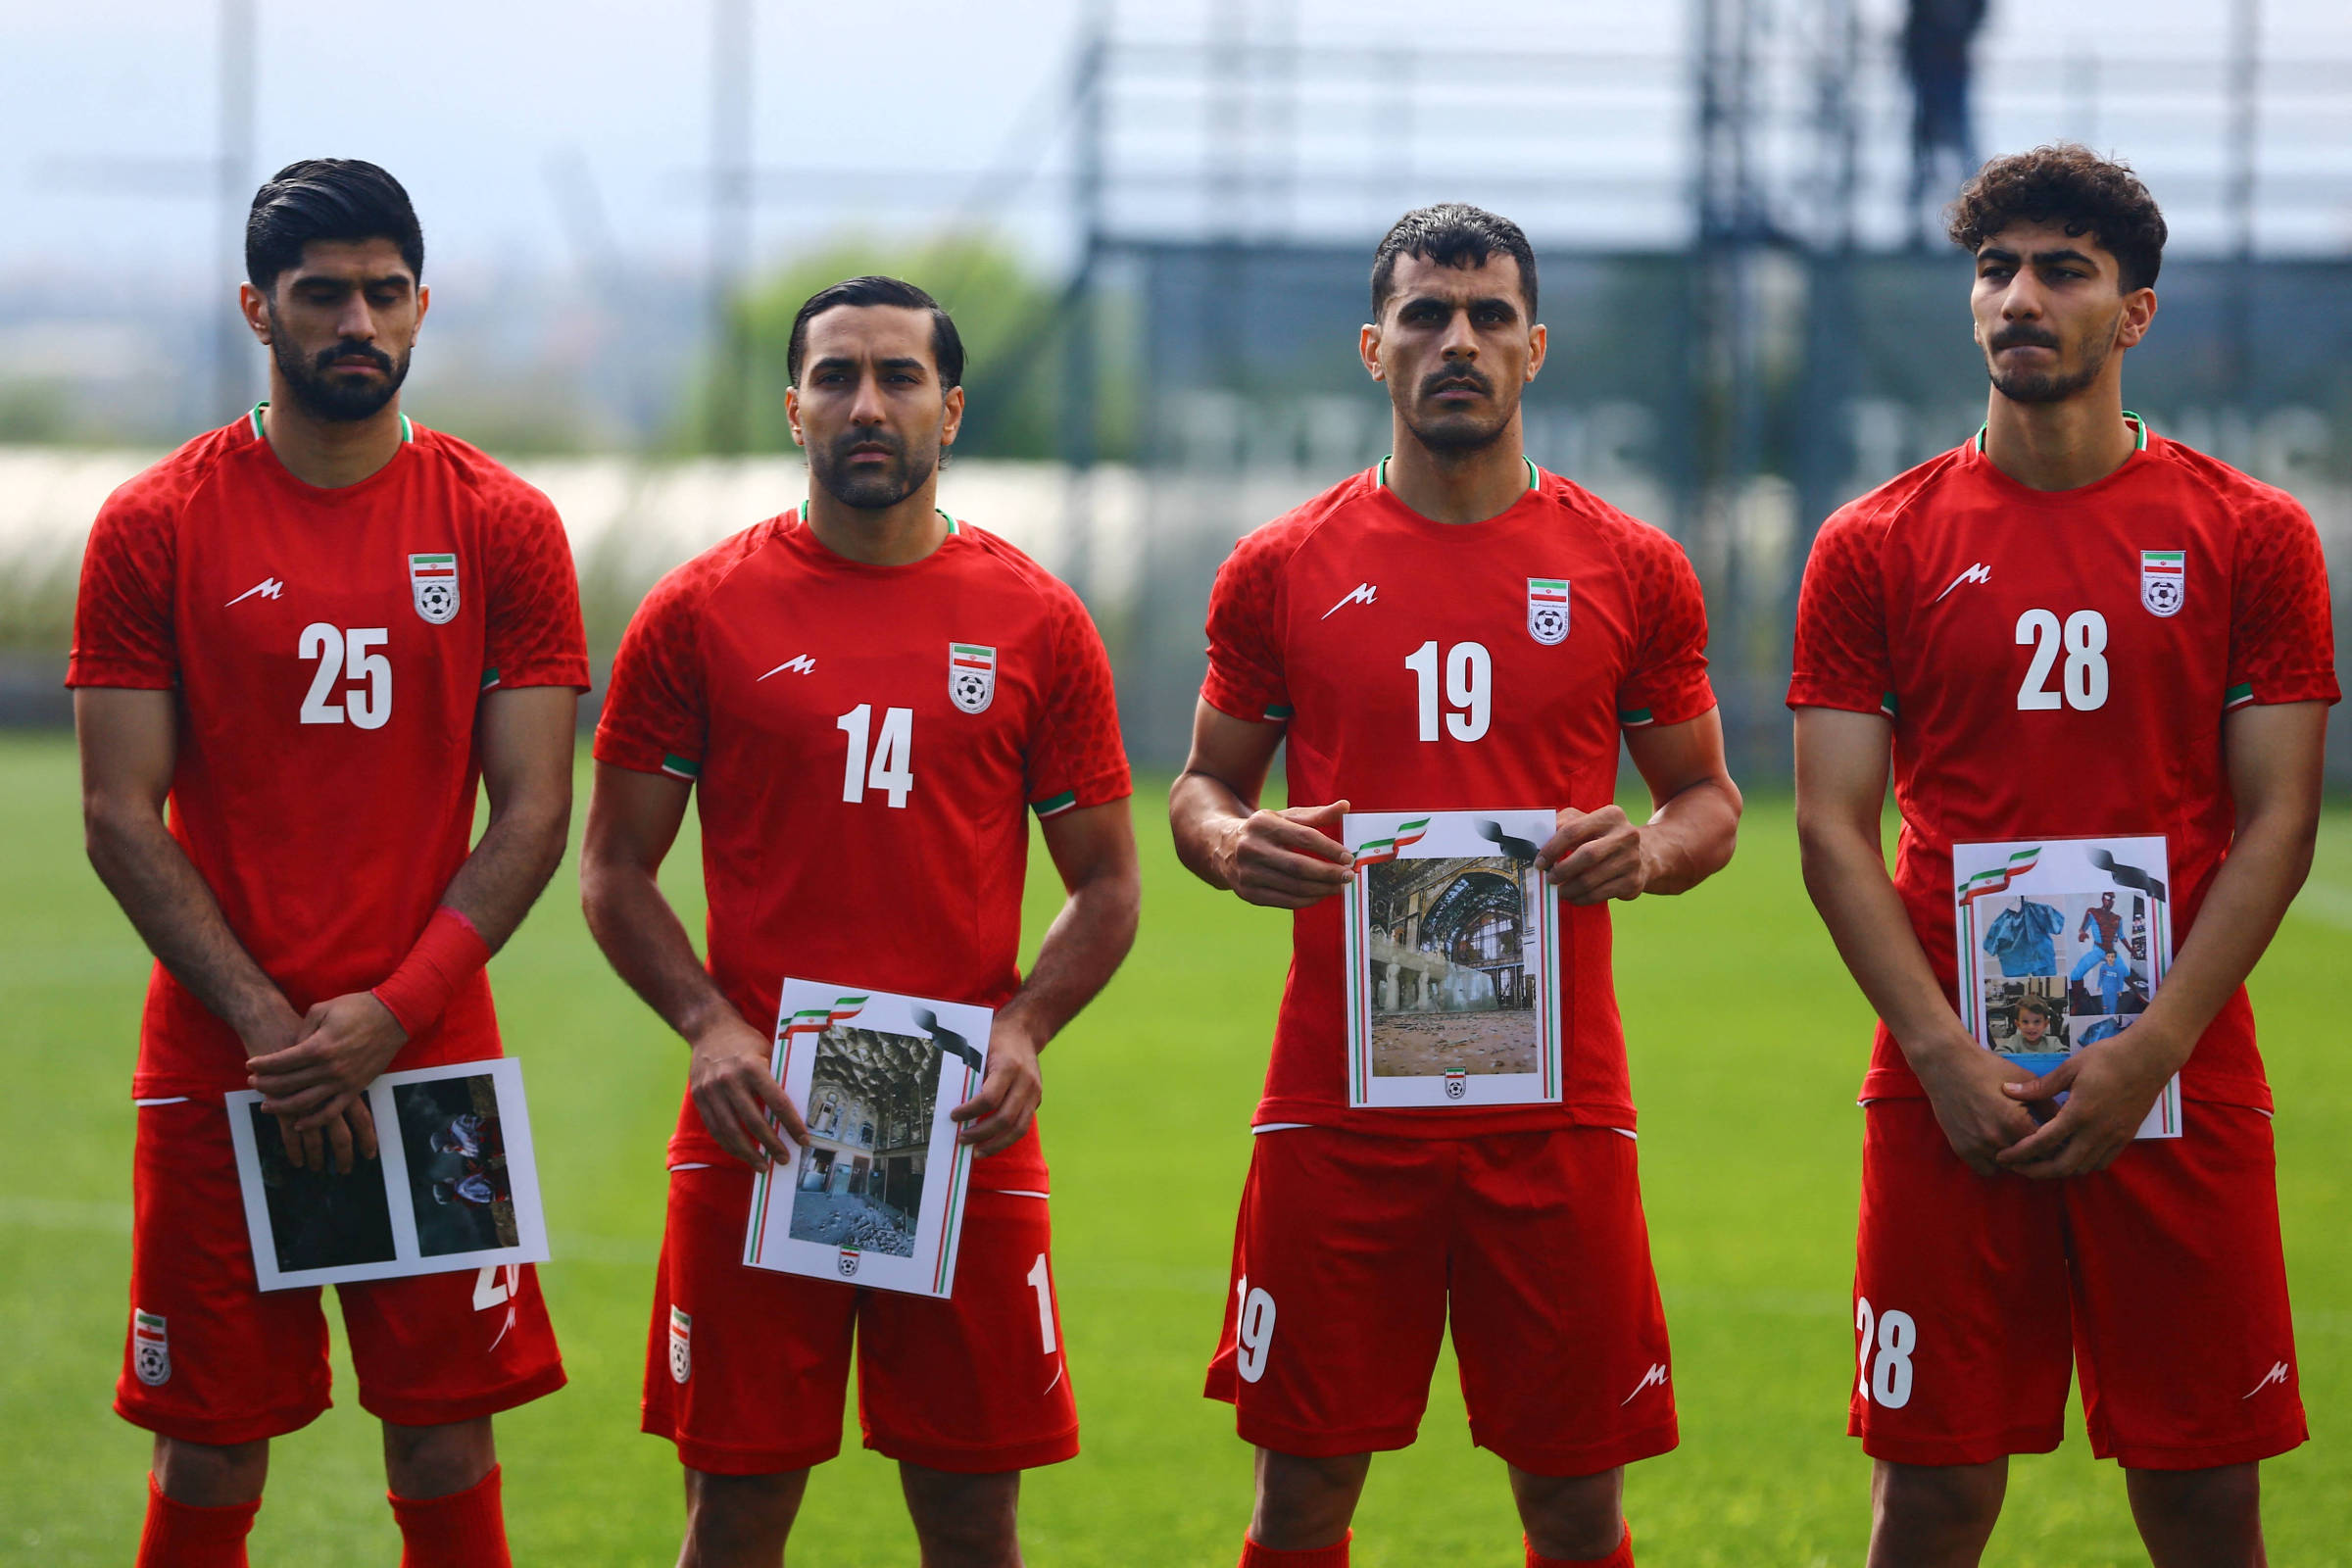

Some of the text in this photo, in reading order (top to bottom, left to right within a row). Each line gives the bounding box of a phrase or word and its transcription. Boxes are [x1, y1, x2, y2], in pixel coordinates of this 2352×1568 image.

[298, 621, 393, 730] 25
[1404, 640, 1493, 743] 19
[2015, 608, 2110, 712] 28
[836, 703, 914, 809] 14
[1026, 1251, 1057, 1355] 1
[1855, 1296, 1918, 1409] 28
